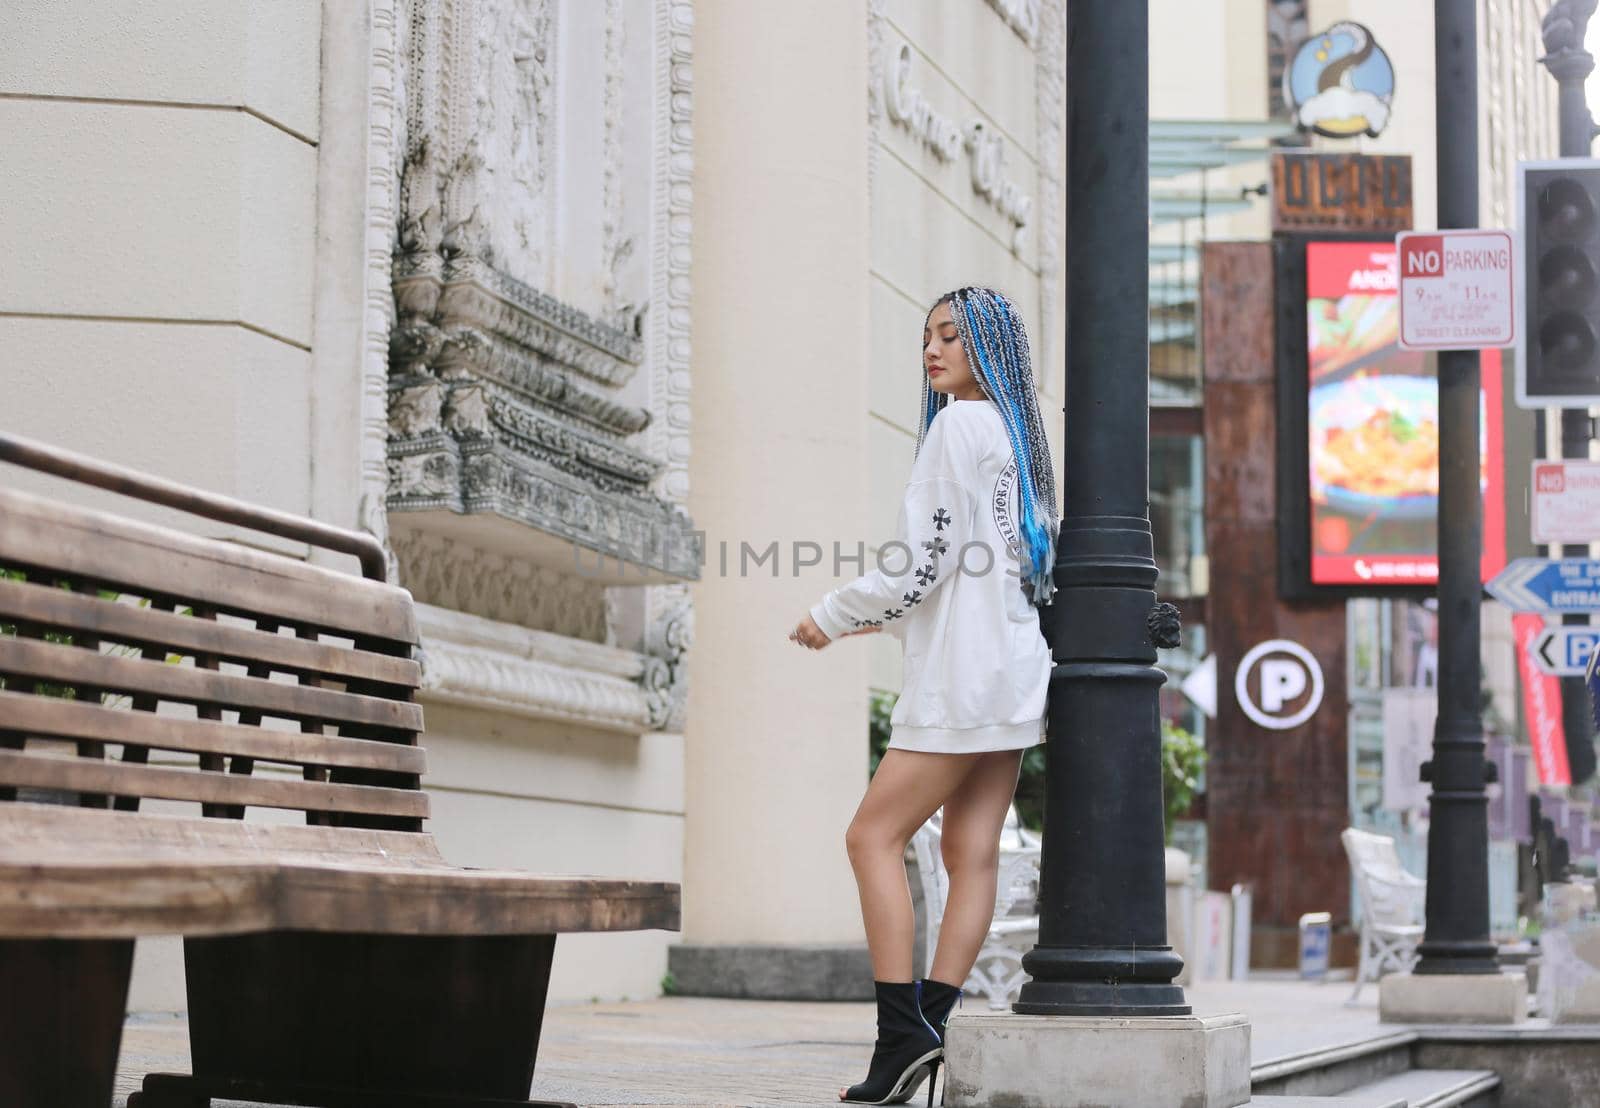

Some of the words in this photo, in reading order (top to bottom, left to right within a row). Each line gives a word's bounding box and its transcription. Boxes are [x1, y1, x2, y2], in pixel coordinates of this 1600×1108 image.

[1284, 153, 1409, 207] OCTO
[1408, 250, 1440, 274] NO
[1446, 249, 1508, 271] PARKING
[1464, 286, 1480, 301] 11
[1571, 636, 1594, 667] P
[1261, 660, 1307, 712] P
